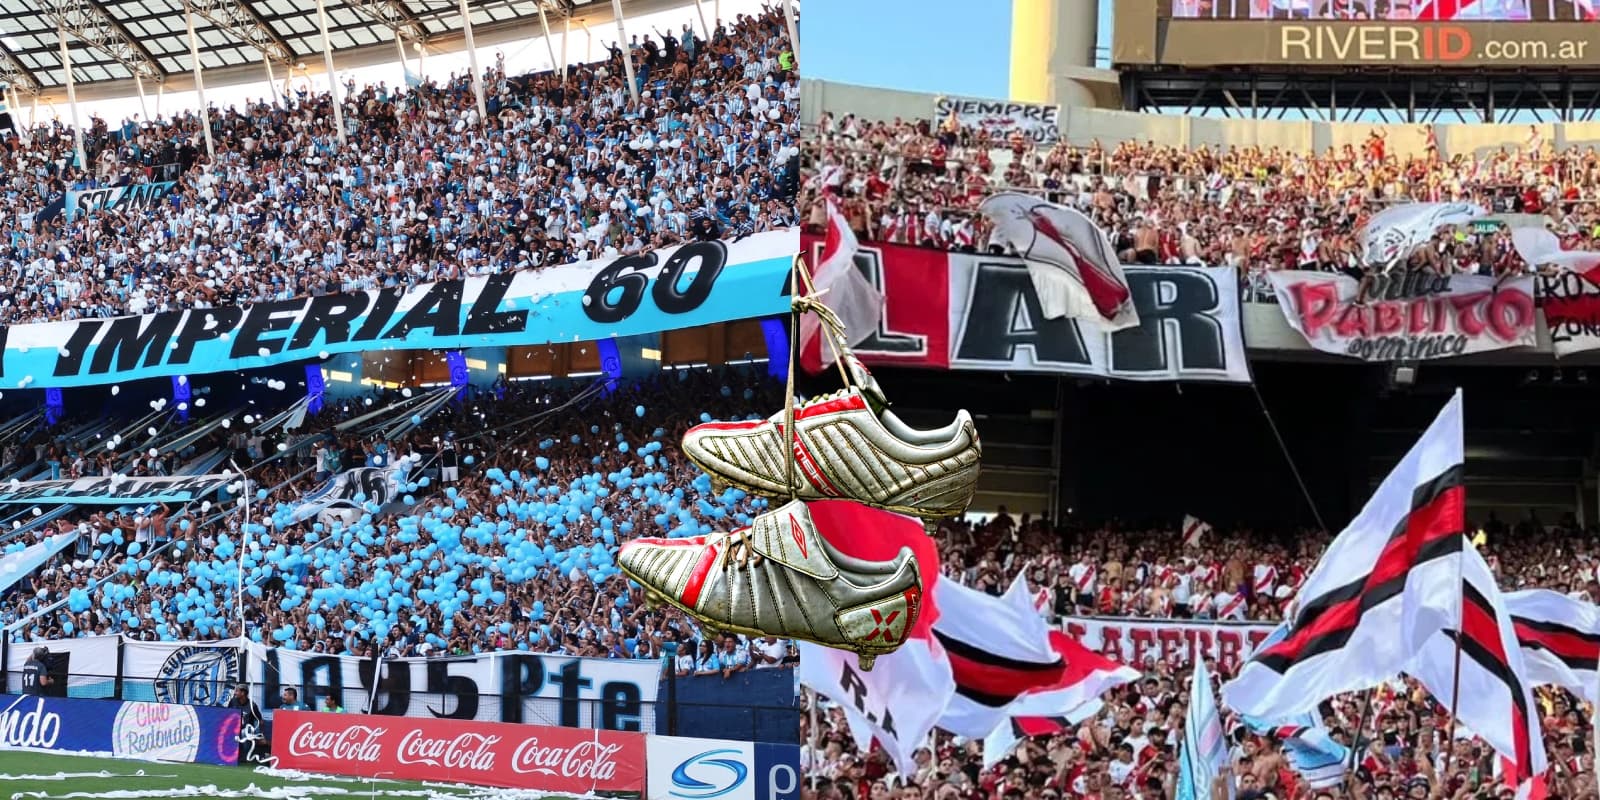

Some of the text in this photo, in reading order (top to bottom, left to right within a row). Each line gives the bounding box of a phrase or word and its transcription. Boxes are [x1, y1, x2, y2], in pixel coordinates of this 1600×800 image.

[937, 98, 1058, 123] SIEMPRE
[52, 272, 529, 378] IMPERIAL
[582, 240, 728, 324] 60
[1288, 283, 1536, 342] PABLITO
[136, 703, 170, 727] Club
[127, 720, 193, 754] Redondo
[288, 721, 389, 763] Coca-Cola
[396, 729, 502, 771] Coca-Cola
[511, 737, 623, 780] Coca-Cola
